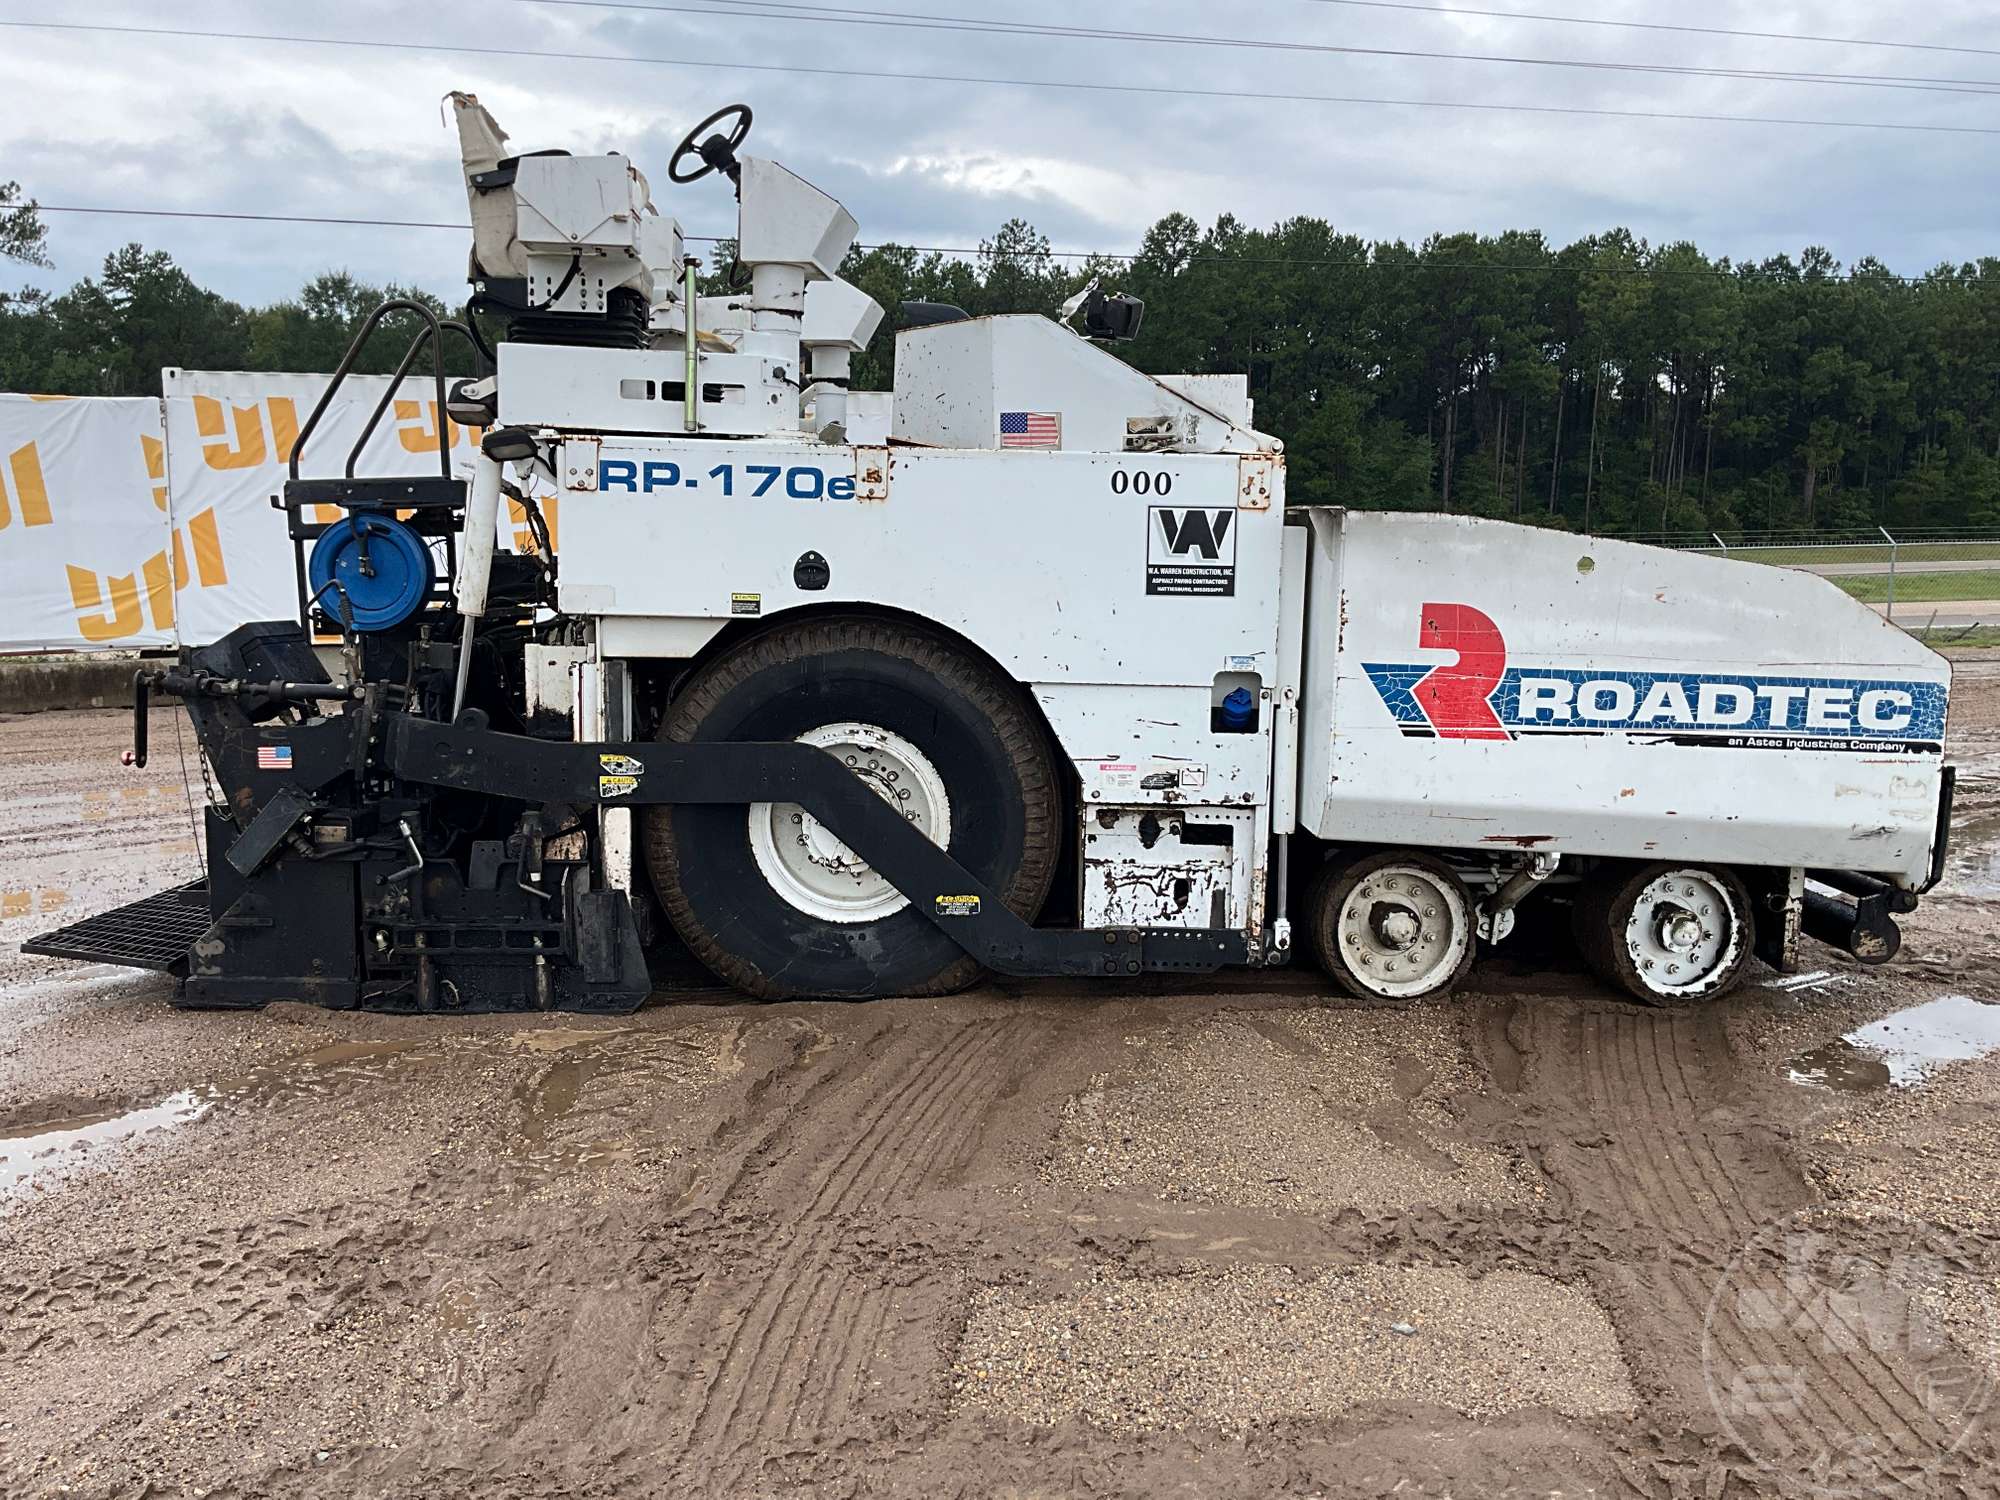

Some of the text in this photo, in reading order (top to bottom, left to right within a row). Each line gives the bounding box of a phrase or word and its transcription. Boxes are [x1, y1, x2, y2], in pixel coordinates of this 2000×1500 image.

[1111, 470, 1172, 495] 000
[1160, 567, 1182, 575] WARREN
[1182, 567, 1223, 577] CONSTRUCTION,
[1517, 676, 1914, 732] ROADTEC
[1727, 737, 1906, 752] an Astec Industries Company
